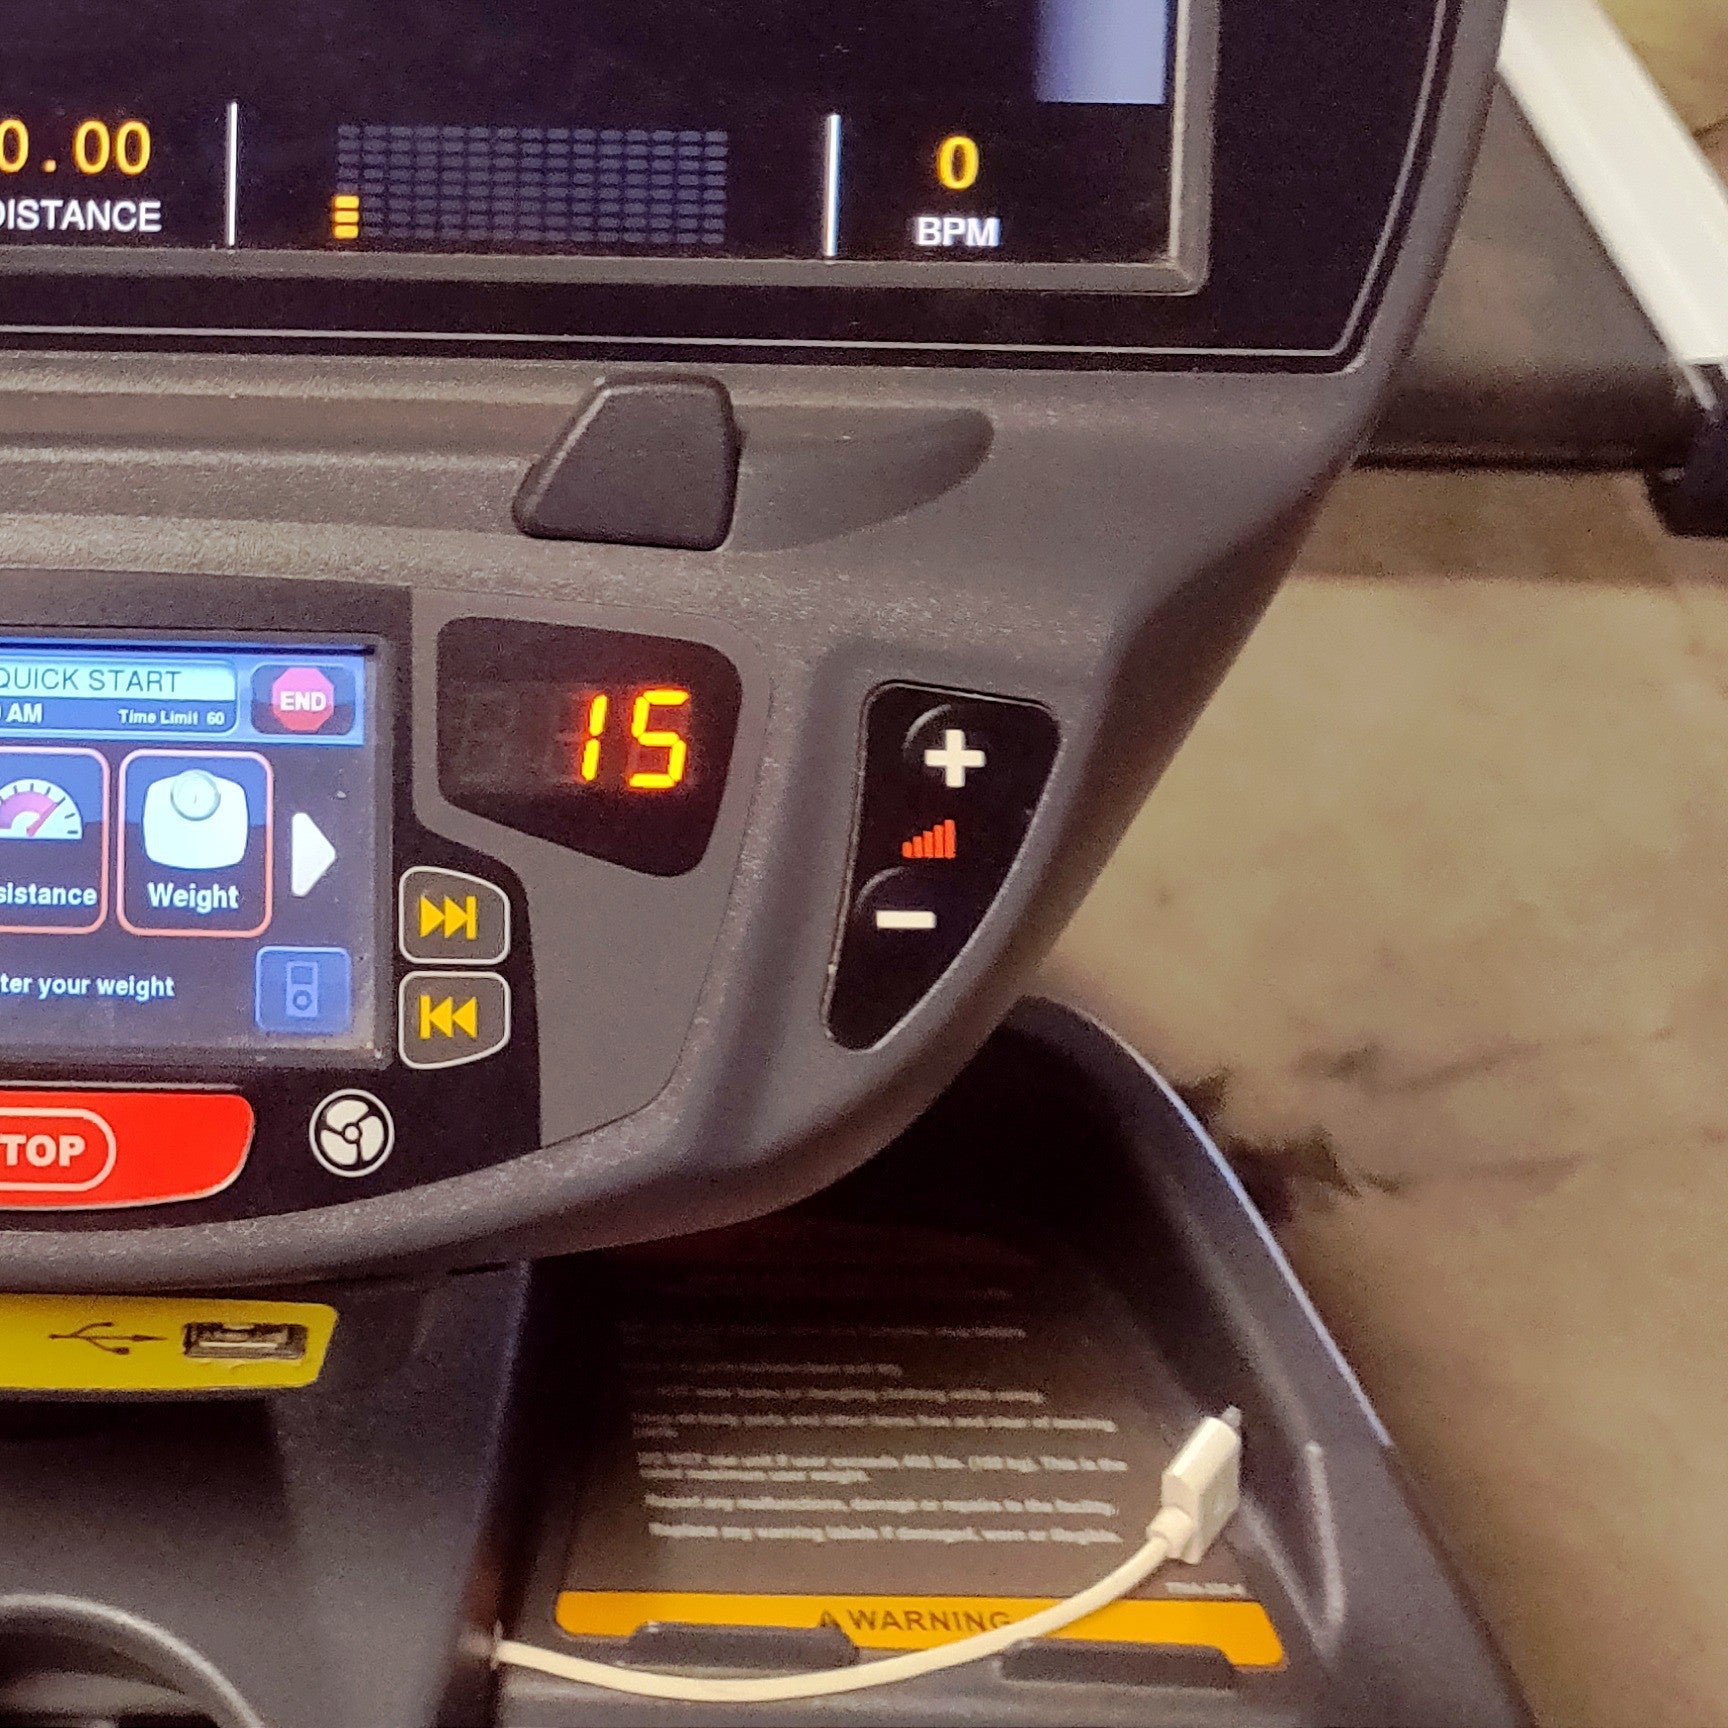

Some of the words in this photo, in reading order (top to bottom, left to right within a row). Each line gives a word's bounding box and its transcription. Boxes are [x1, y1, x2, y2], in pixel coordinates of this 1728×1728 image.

[936, 135, 979, 191] 0
[914, 216, 1001, 247] BPM
[88, 669, 182, 694] START
[5, 702, 43, 725] AM
[279, 690, 328, 712] END
[118, 708, 157, 726] Time
[160, 709, 199, 726] Limit
[206, 712, 226, 727] 60
[580, 688, 691, 790] 15
[146, 881, 240, 915] Weight
[37, 975, 91, 1000] your
[95, 974, 176, 1002] weight
